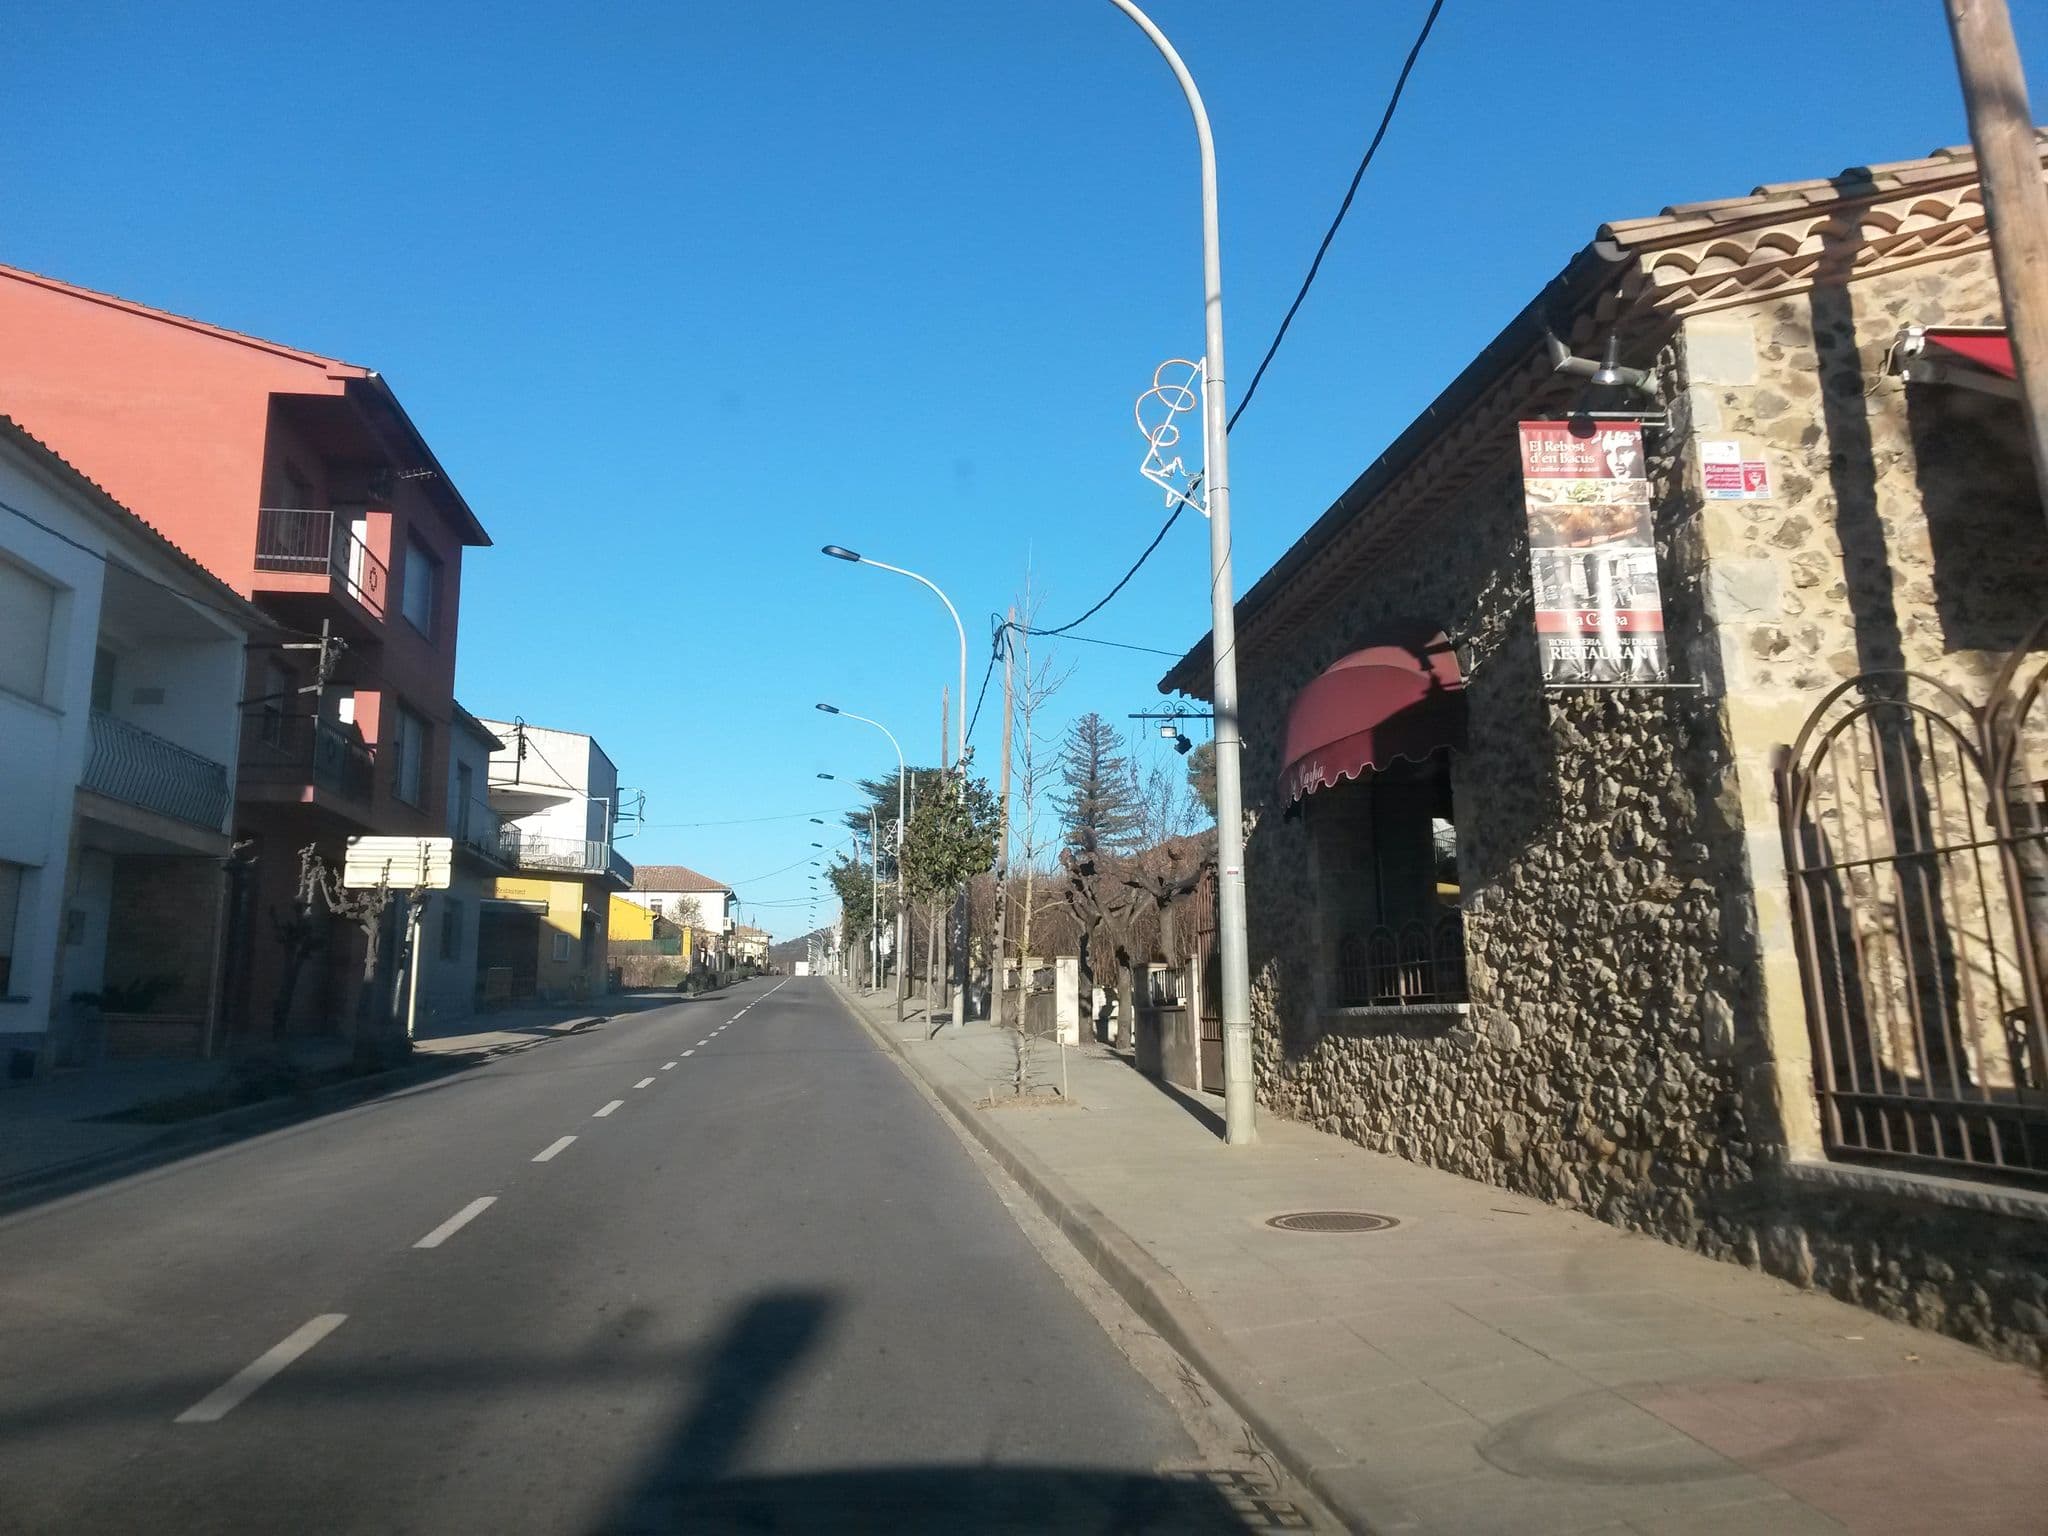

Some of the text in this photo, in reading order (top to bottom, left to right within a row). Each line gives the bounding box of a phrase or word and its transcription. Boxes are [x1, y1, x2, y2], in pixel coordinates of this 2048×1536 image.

[1529, 440, 1586, 452] El Rebost
[1530, 452, 1596, 464] d'en Bacus
[1550, 646, 1659, 660] RESTAURANT
